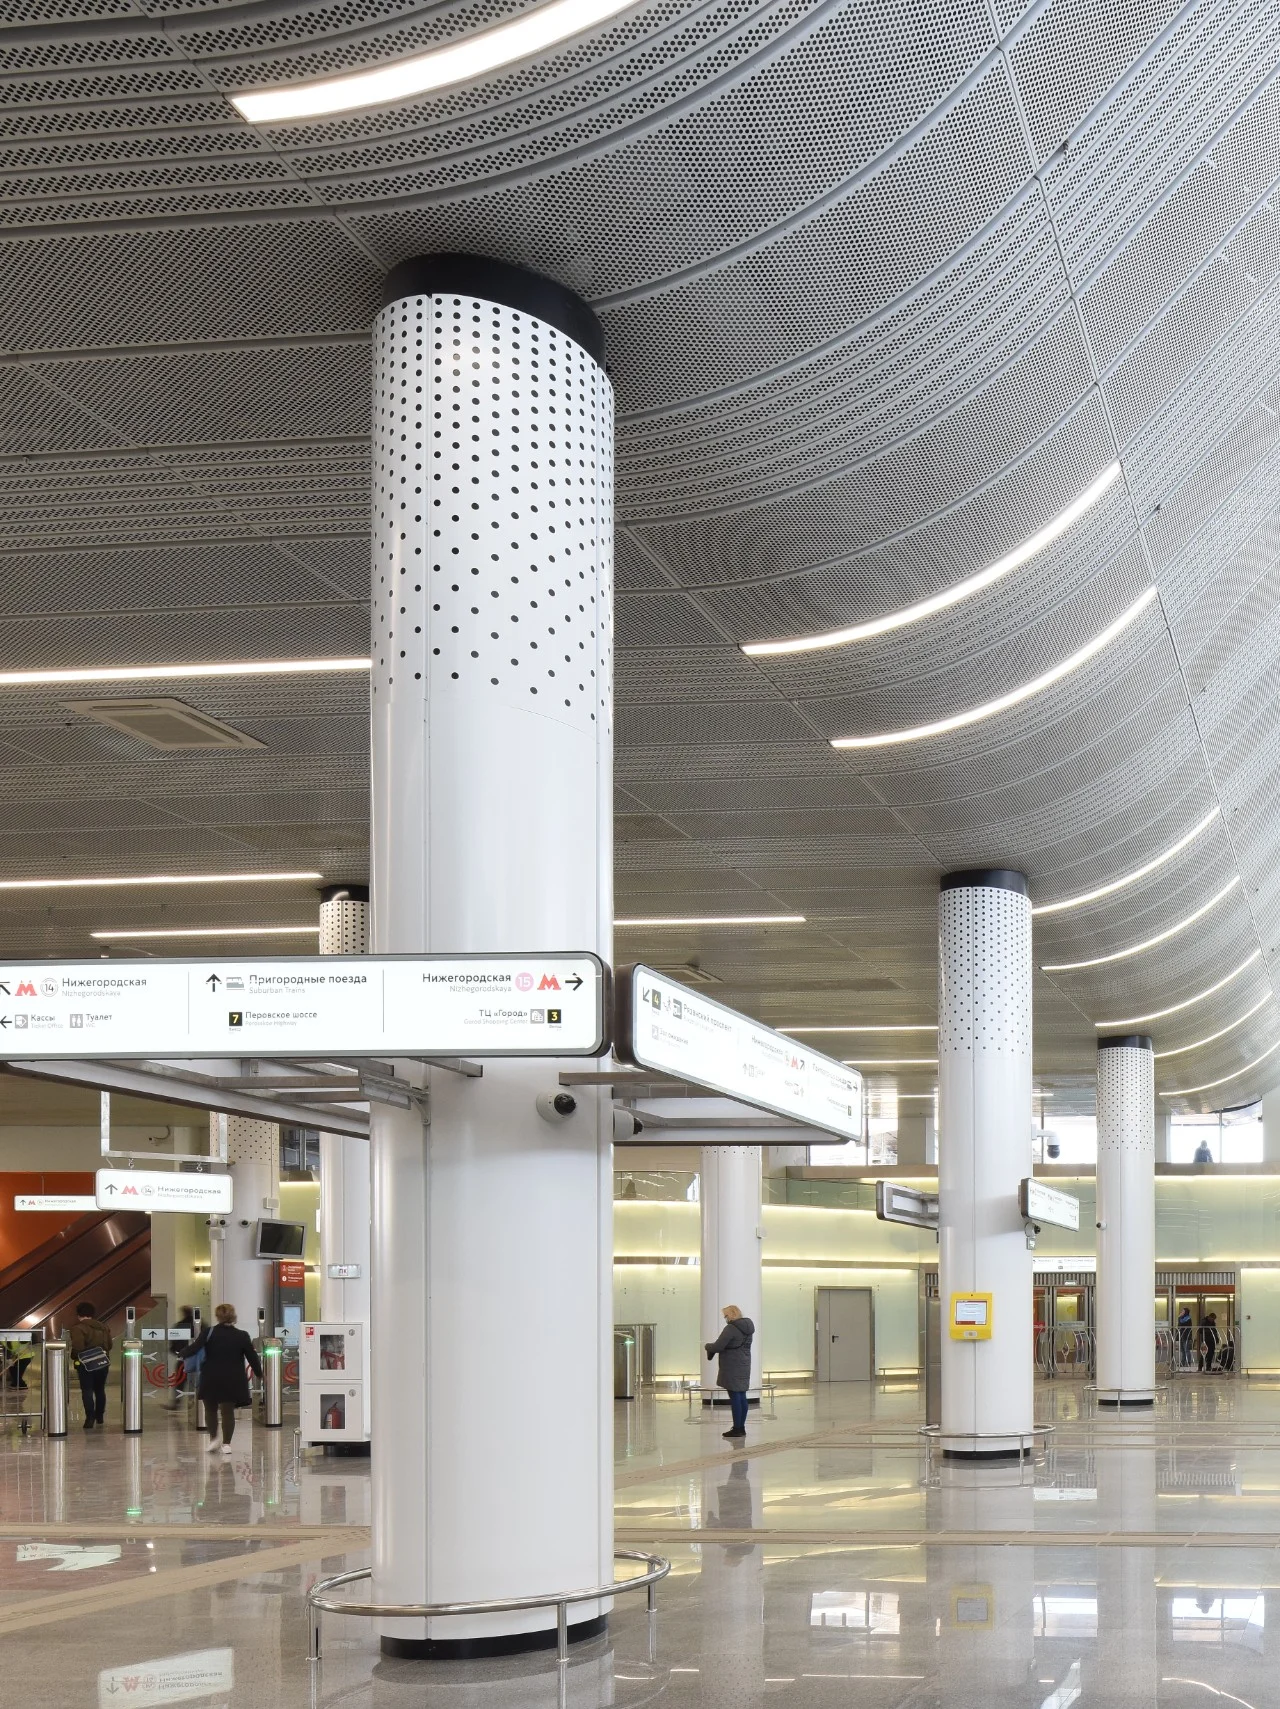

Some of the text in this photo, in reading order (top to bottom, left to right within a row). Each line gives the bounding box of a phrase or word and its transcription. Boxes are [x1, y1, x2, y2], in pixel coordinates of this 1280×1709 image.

[249, 975, 367, 986] Пригородные поезда
[422, 973, 512, 984] Нижегородская
[517, 976, 531, 987] 15
[44, 982, 55, 993] 14
[62, 978, 147, 988] Нижегородская
[249, 986, 306, 994] Suburban Trains
[449, 985, 512, 993] Nizhegorodskaya
[31, 1014, 56, 1022] Кассы
[86, 1014, 113, 1022] Туалет
[233, 1014, 239, 1024] 7
[245, 1011, 291, 1020] Перовское
[479, 1009, 558, 1021] ТЦ «Город» 3
[157, 1185, 222, 1195] Нижегородская
